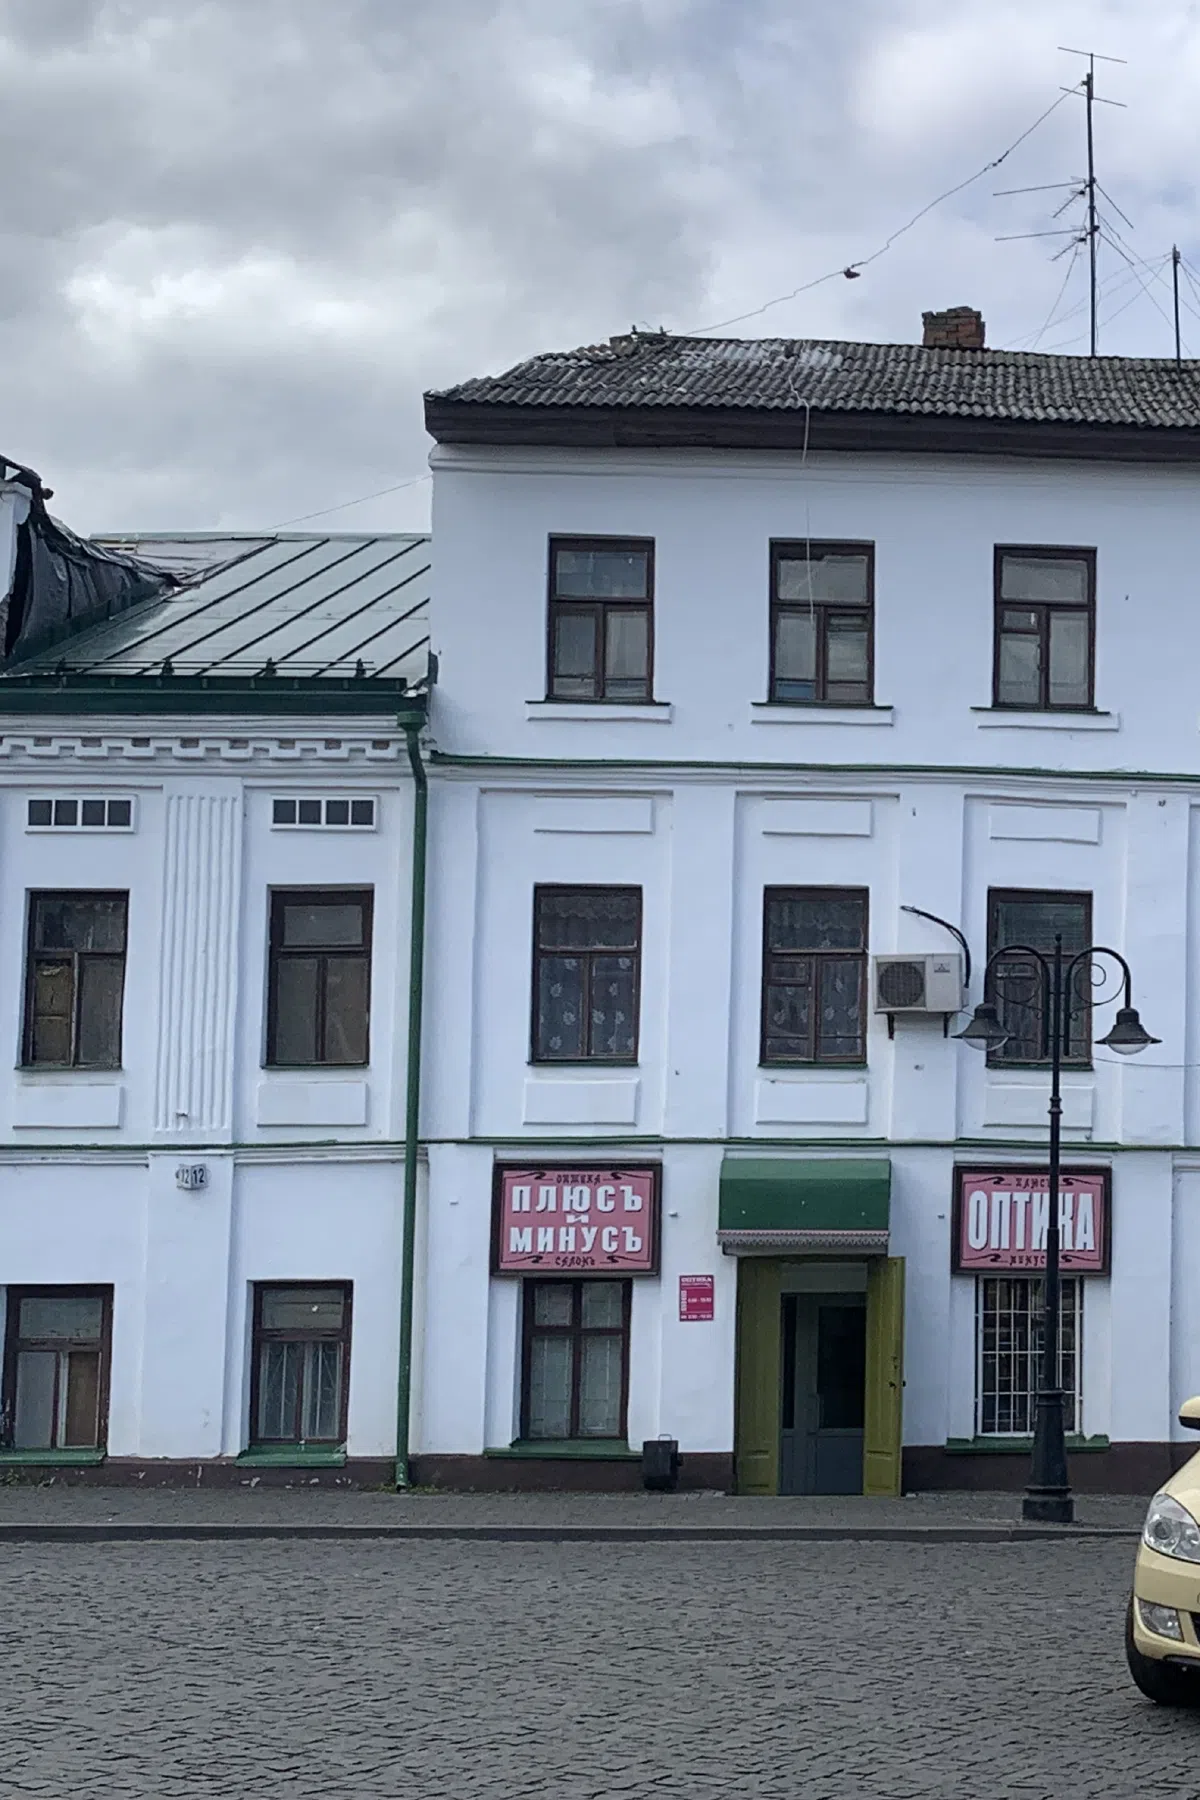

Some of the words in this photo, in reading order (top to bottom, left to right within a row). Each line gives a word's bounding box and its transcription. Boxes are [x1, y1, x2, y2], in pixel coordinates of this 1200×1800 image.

[193, 1168, 204, 1184] 12
[511, 1185, 643, 1212] ПЛЮСЪ
[968, 1190, 1095, 1251] ОПТИКА
[509, 1226, 643, 1253] МИНУСЪ
